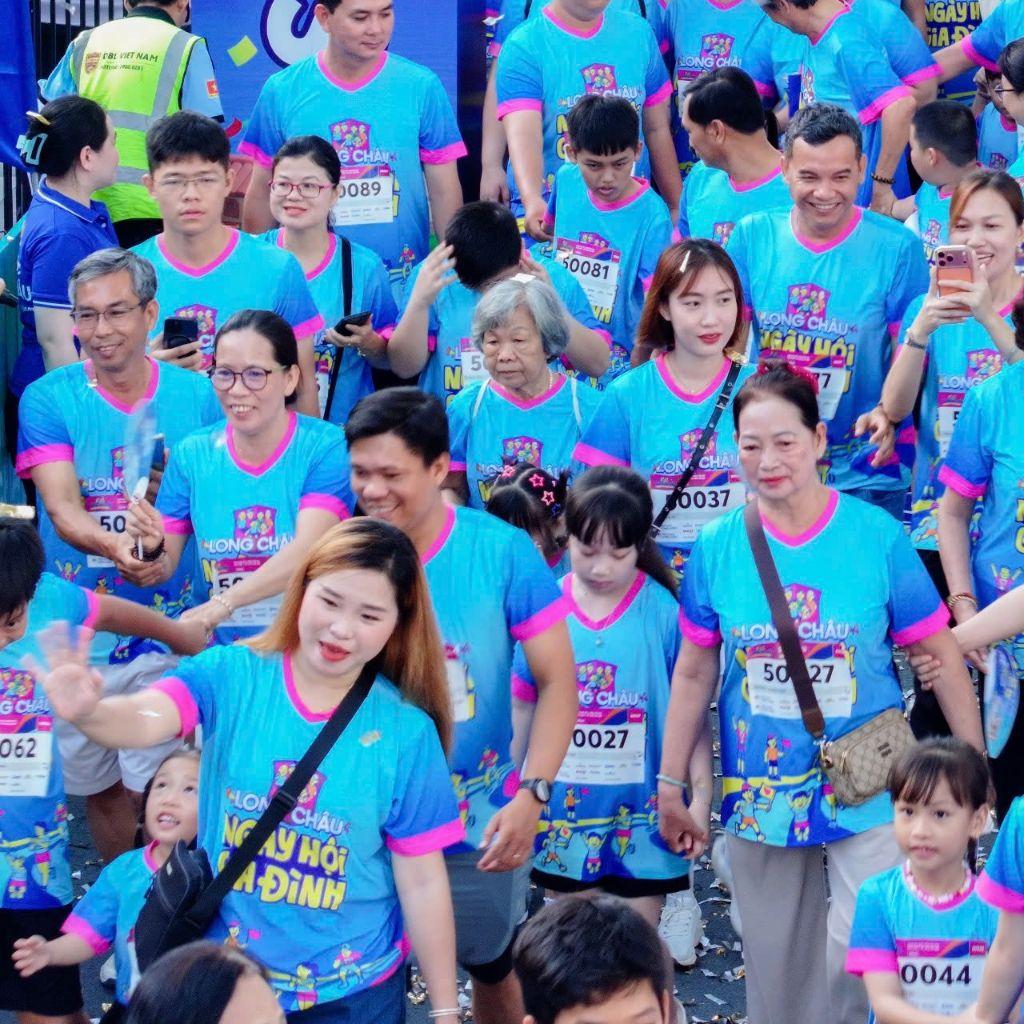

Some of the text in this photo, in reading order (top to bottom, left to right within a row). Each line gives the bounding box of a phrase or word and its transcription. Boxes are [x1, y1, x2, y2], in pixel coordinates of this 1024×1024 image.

[337, 180, 382, 199] 089
[561, 255, 611, 280] 50081
[209, 538, 254, 553] LONG
[740, 621, 850, 641] LON CHÂU
[763, 663, 835, 684] 5027
[598, 688, 639, 707] CHÂU
[0, 738, 37, 759] 062
[572, 728, 629, 749] 0027
[233, 793, 346, 835] LON CHÂU
[901, 963, 973, 987] 0044
